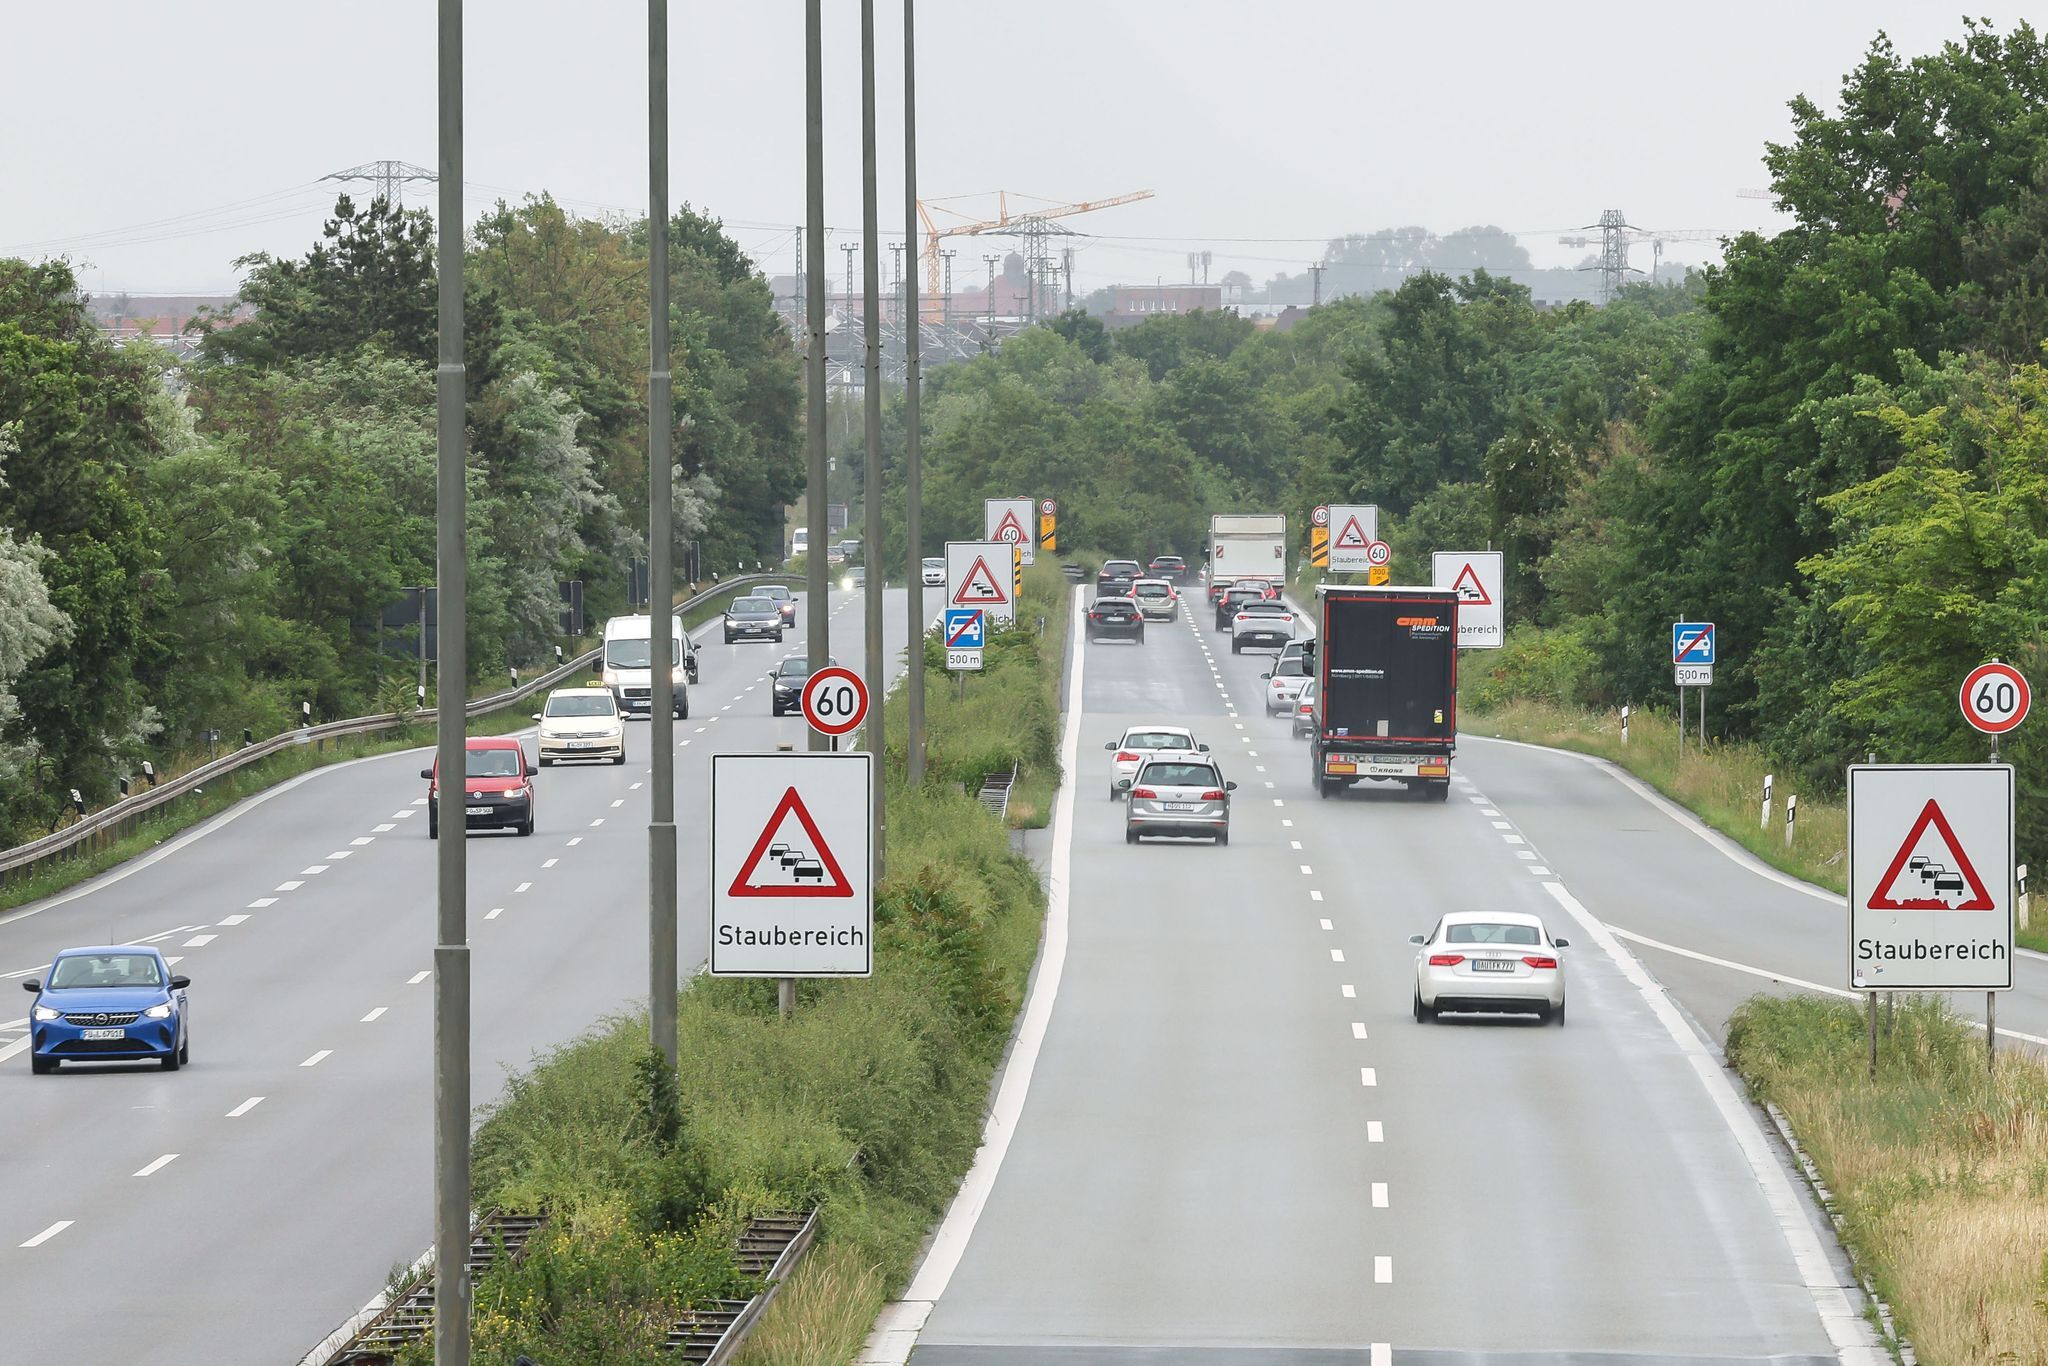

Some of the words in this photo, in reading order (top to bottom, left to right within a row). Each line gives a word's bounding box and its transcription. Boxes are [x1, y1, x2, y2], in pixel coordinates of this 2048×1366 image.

[1044, 503, 1053, 512] 60
[1316, 511, 1328, 521] 60
[1004, 529, 1017, 541] 60
[1331, 555, 1370, 564] Staubereic
[1371, 548, 1386, 560] 60
[1372, 568, 1386, 576] 300
[949, 654, 968, 664] 500
[970, 656, 980, 664] m
[1678, 670, 1698, 680] 500
[1699, 672, 1709, 680] m
[816, 686, 854, 716] 60
[1975, 682, 2015, 714] 60
[718, 924, 864, 947] Staubereich
[1857, 938, 2006, 961] Staubereich
